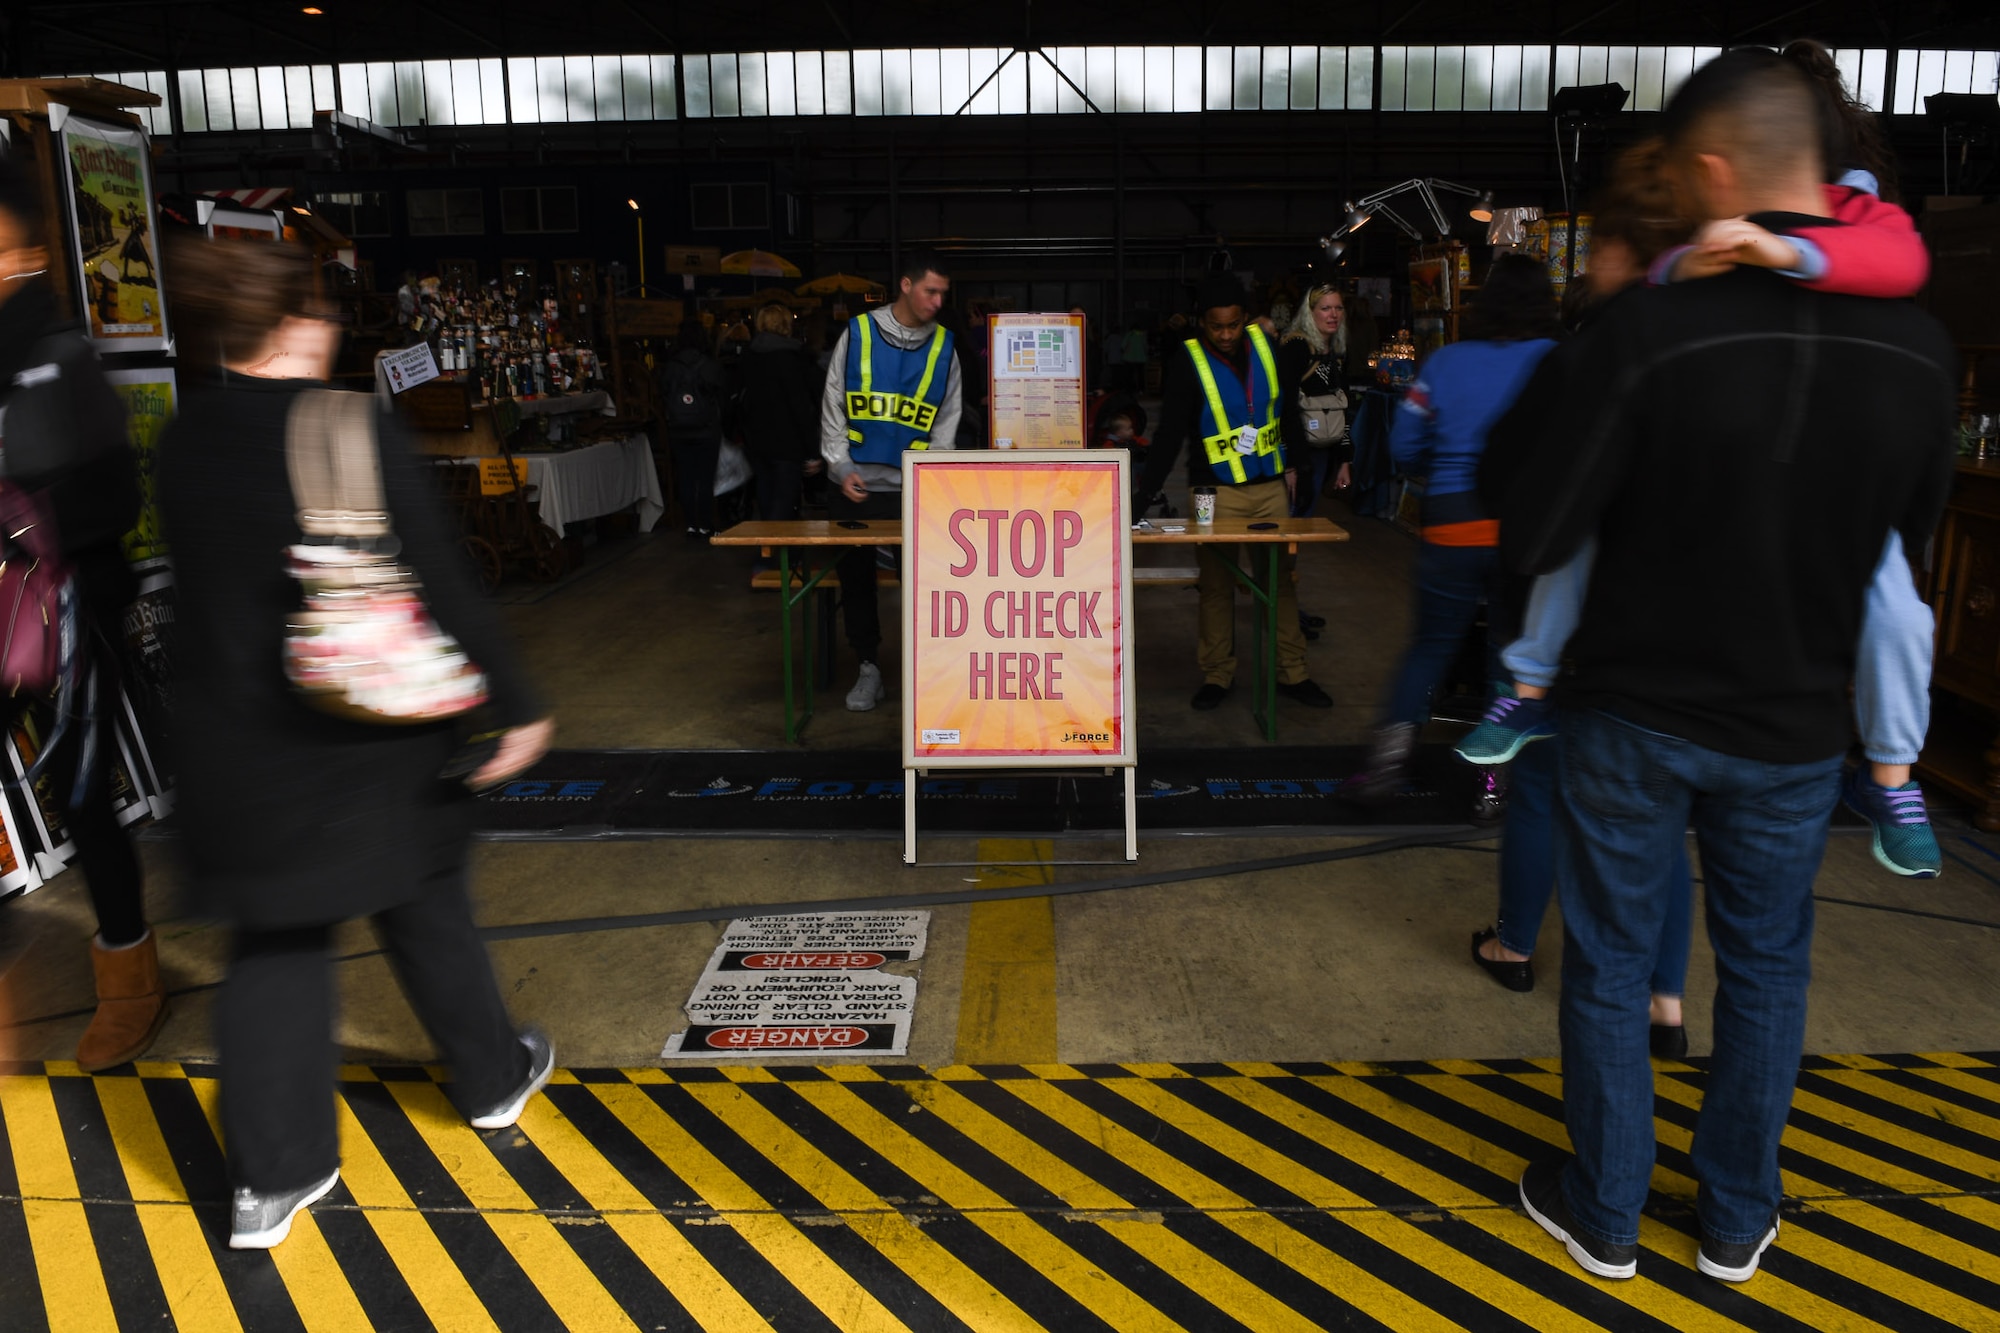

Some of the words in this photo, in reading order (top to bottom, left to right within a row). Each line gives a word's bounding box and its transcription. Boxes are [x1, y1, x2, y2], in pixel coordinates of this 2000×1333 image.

[948, 508, 1083, 578] STOP
[930, 590, 969, 638] ID
[983, 590, 1103, 639] CHECK
[969, 652, 1064, 700] HERE
[1072, 733, 1109, 741] FORCE
[796, 922, 854, 930] GERÄTE
[762, 955, 869, 965] GEFAHR
[700, 994, 740, 1002] NOT
[690, 1003, 760, 1011] DURING
[772, 1003, 832, 1011] CLEAR
[728, 1030, 852, 1044] DANGER
